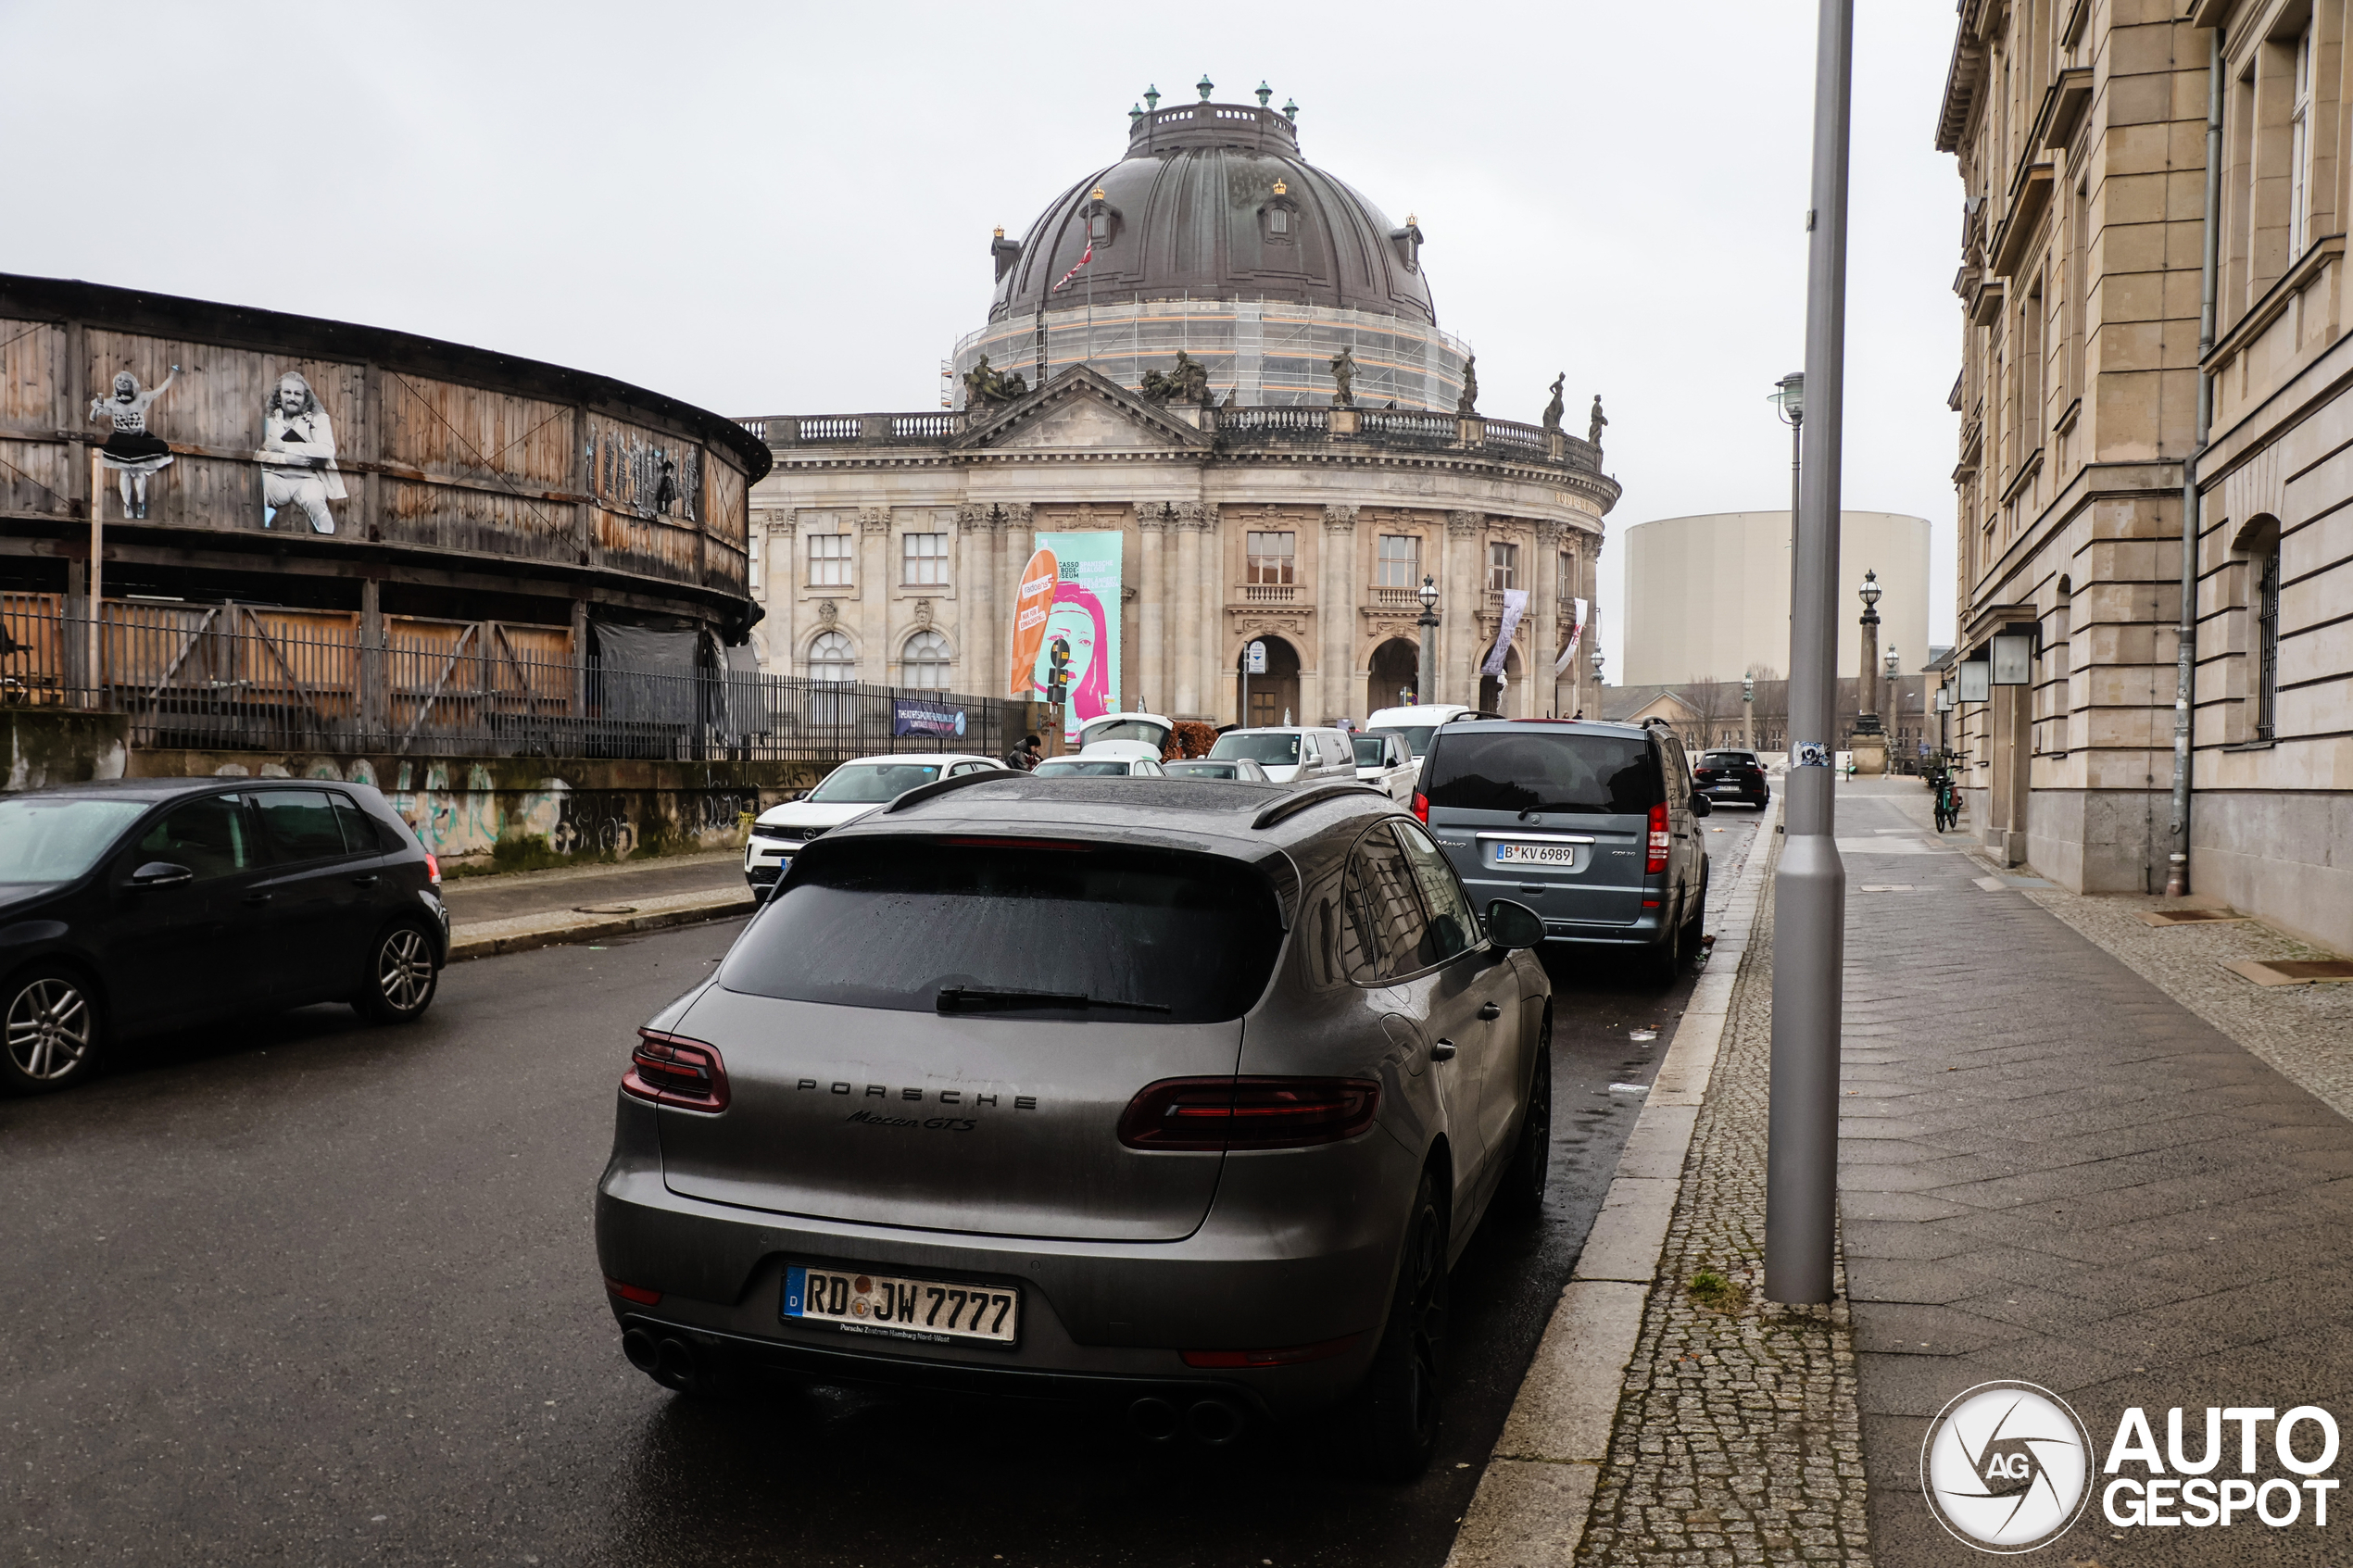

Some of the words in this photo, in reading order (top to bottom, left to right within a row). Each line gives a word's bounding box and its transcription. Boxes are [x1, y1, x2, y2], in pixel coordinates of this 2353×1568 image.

[1505, 847, 1513, 859] B
[1520, 847, 1538, 859] KV
[1540, 848, 1571, 861] 6989
[797, 1078, 1037, 1110] PORSCHE
[845, 1110, 918, 1128] Macan
[923, 1116, 977, 1131] GTS
[789, 1296, 798, 1307] D
[806, 1273, 849, 1315] RD
[874, 1283, 918, 1323] JW
[926, 1287, 1012, 1334] 7777
[839, 1323, 864, 1333] Porsche
[863, 1325, 889, 1336] Zentrum
[889, 1328, 917, 1340] Hamburg
[917, 1332, 950, 1343] Nord-West
